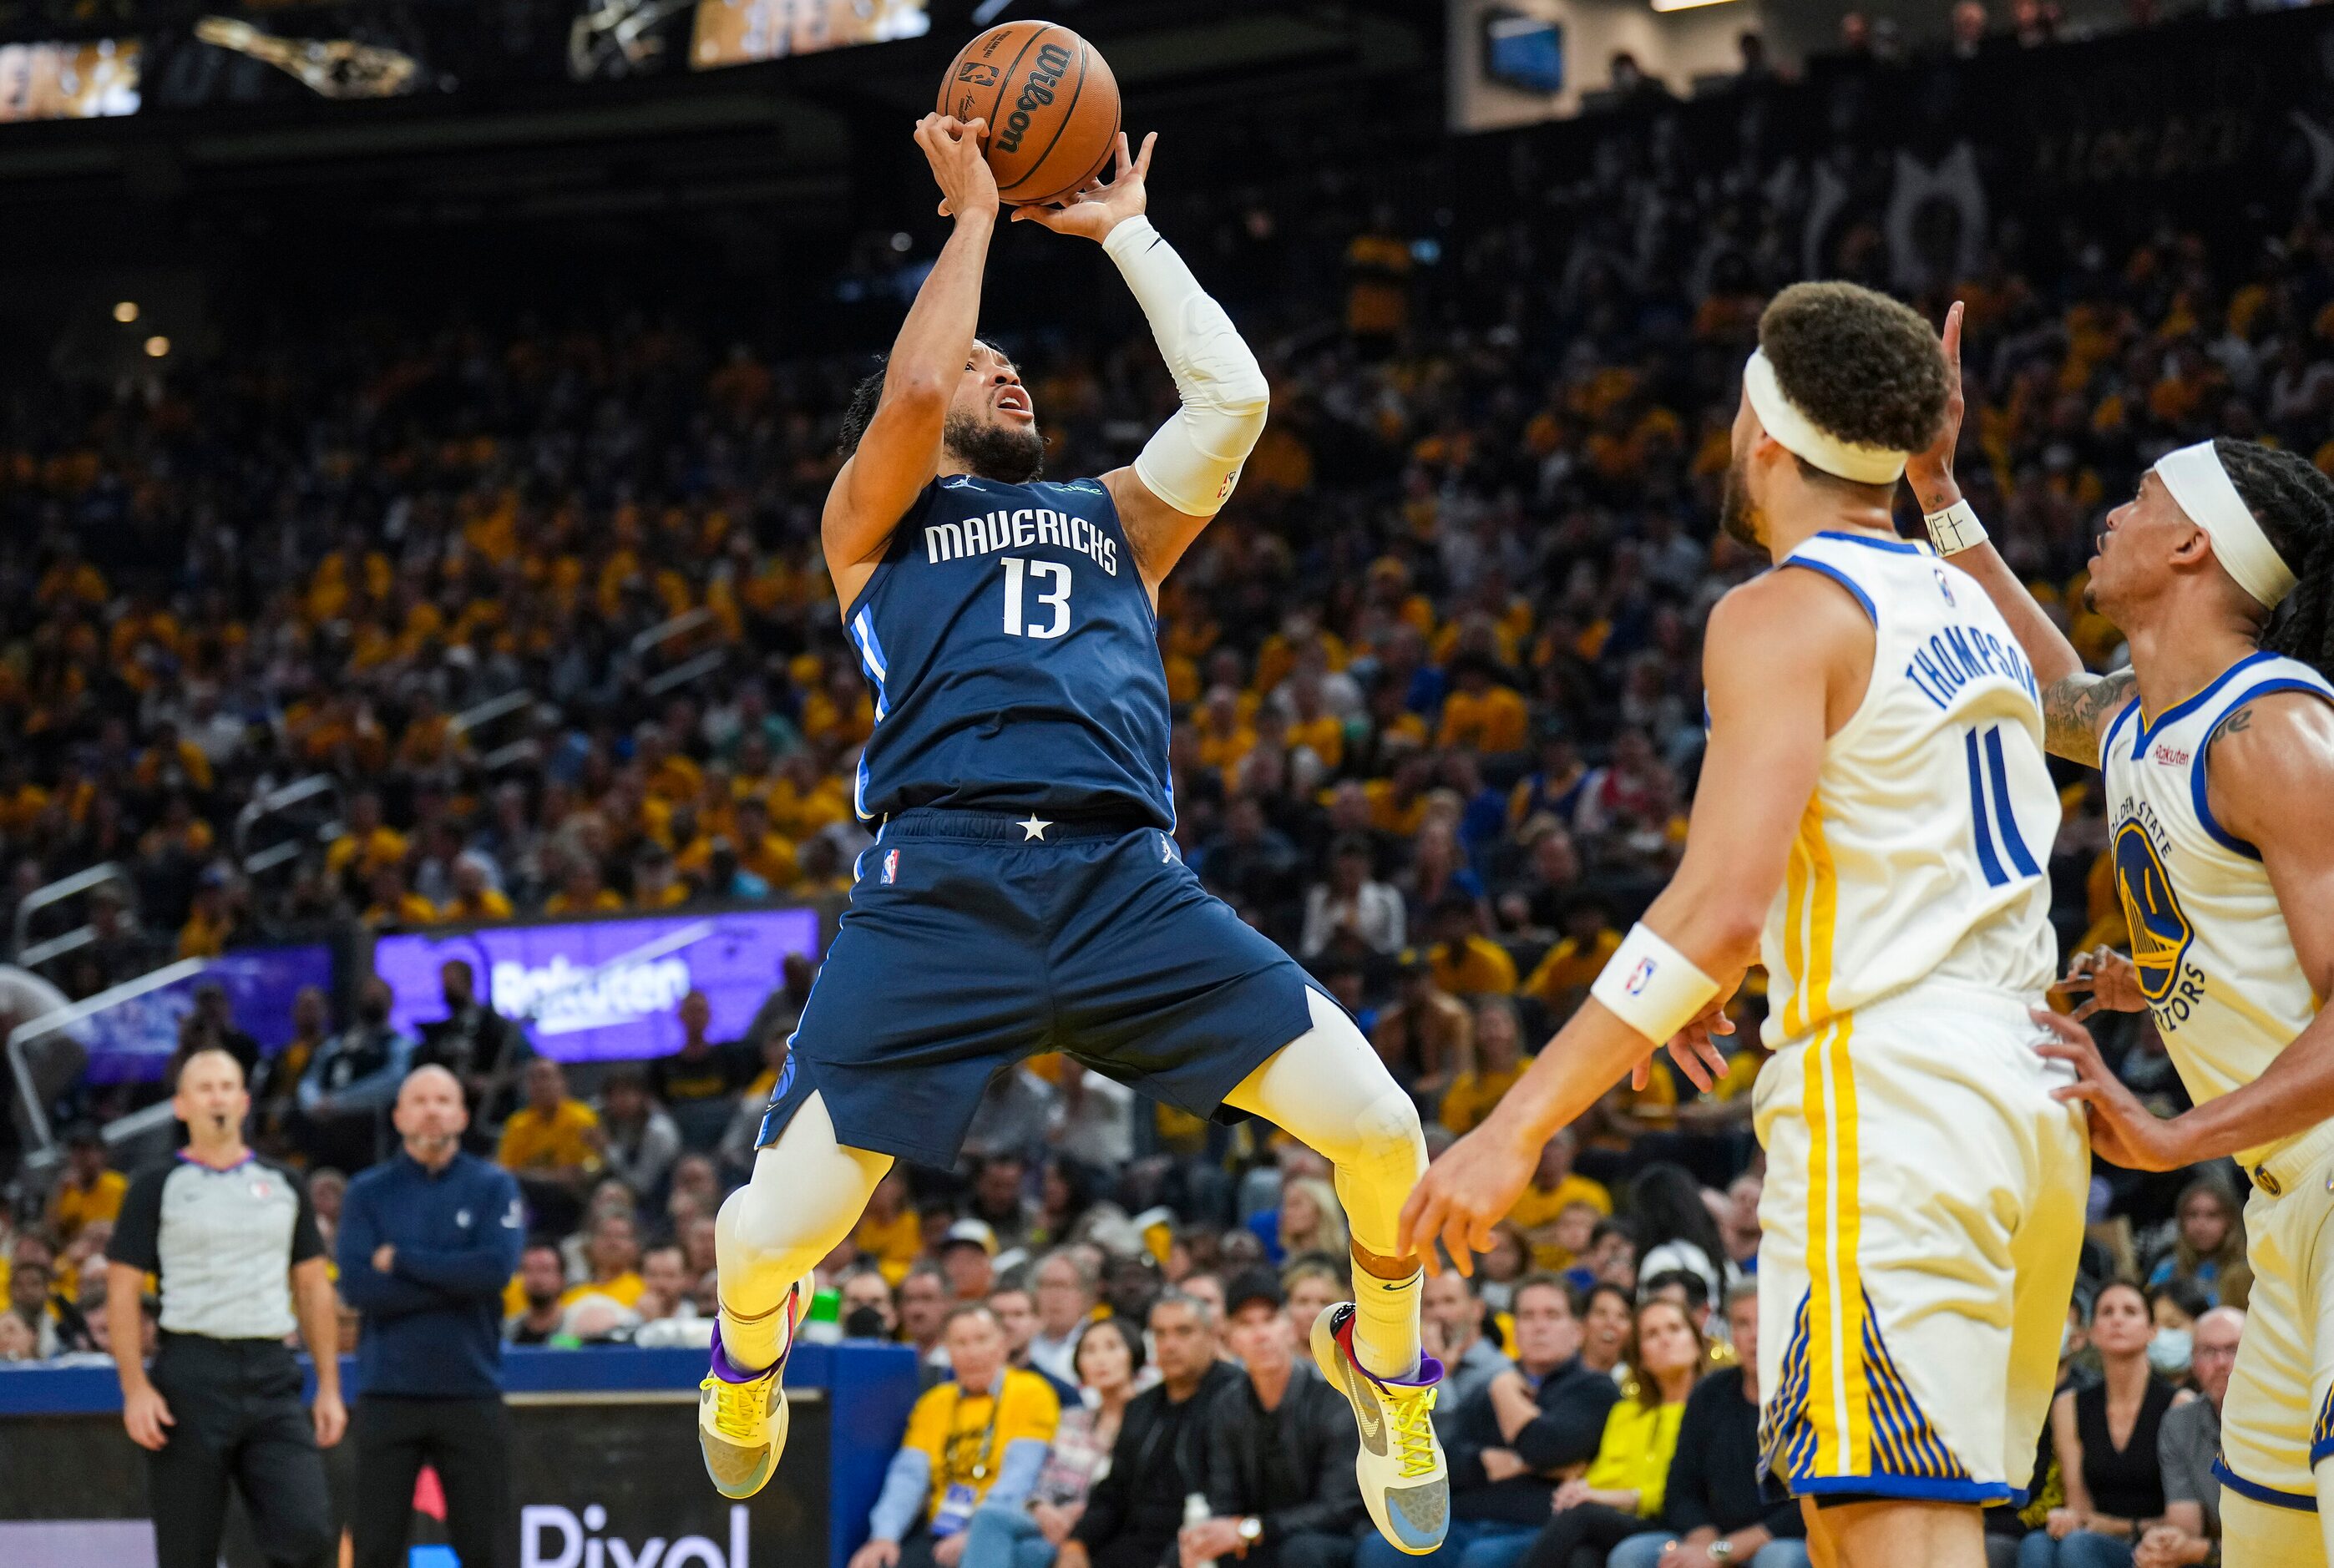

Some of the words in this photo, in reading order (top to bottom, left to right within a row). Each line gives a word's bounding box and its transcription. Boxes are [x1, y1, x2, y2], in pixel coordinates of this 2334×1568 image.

[995, 43, 1074, 154] Wilson
[924, 508, 1117, 577] MAVERICKS
[1000, 556, 1072, 640] 13
[2154, 744, 2190, 766] Rakuten
[1966, 724, 2043, 889] 11
[2109, 796, 2134, 852] OLDEN
[2137, 801, 2172, 859] STATE
